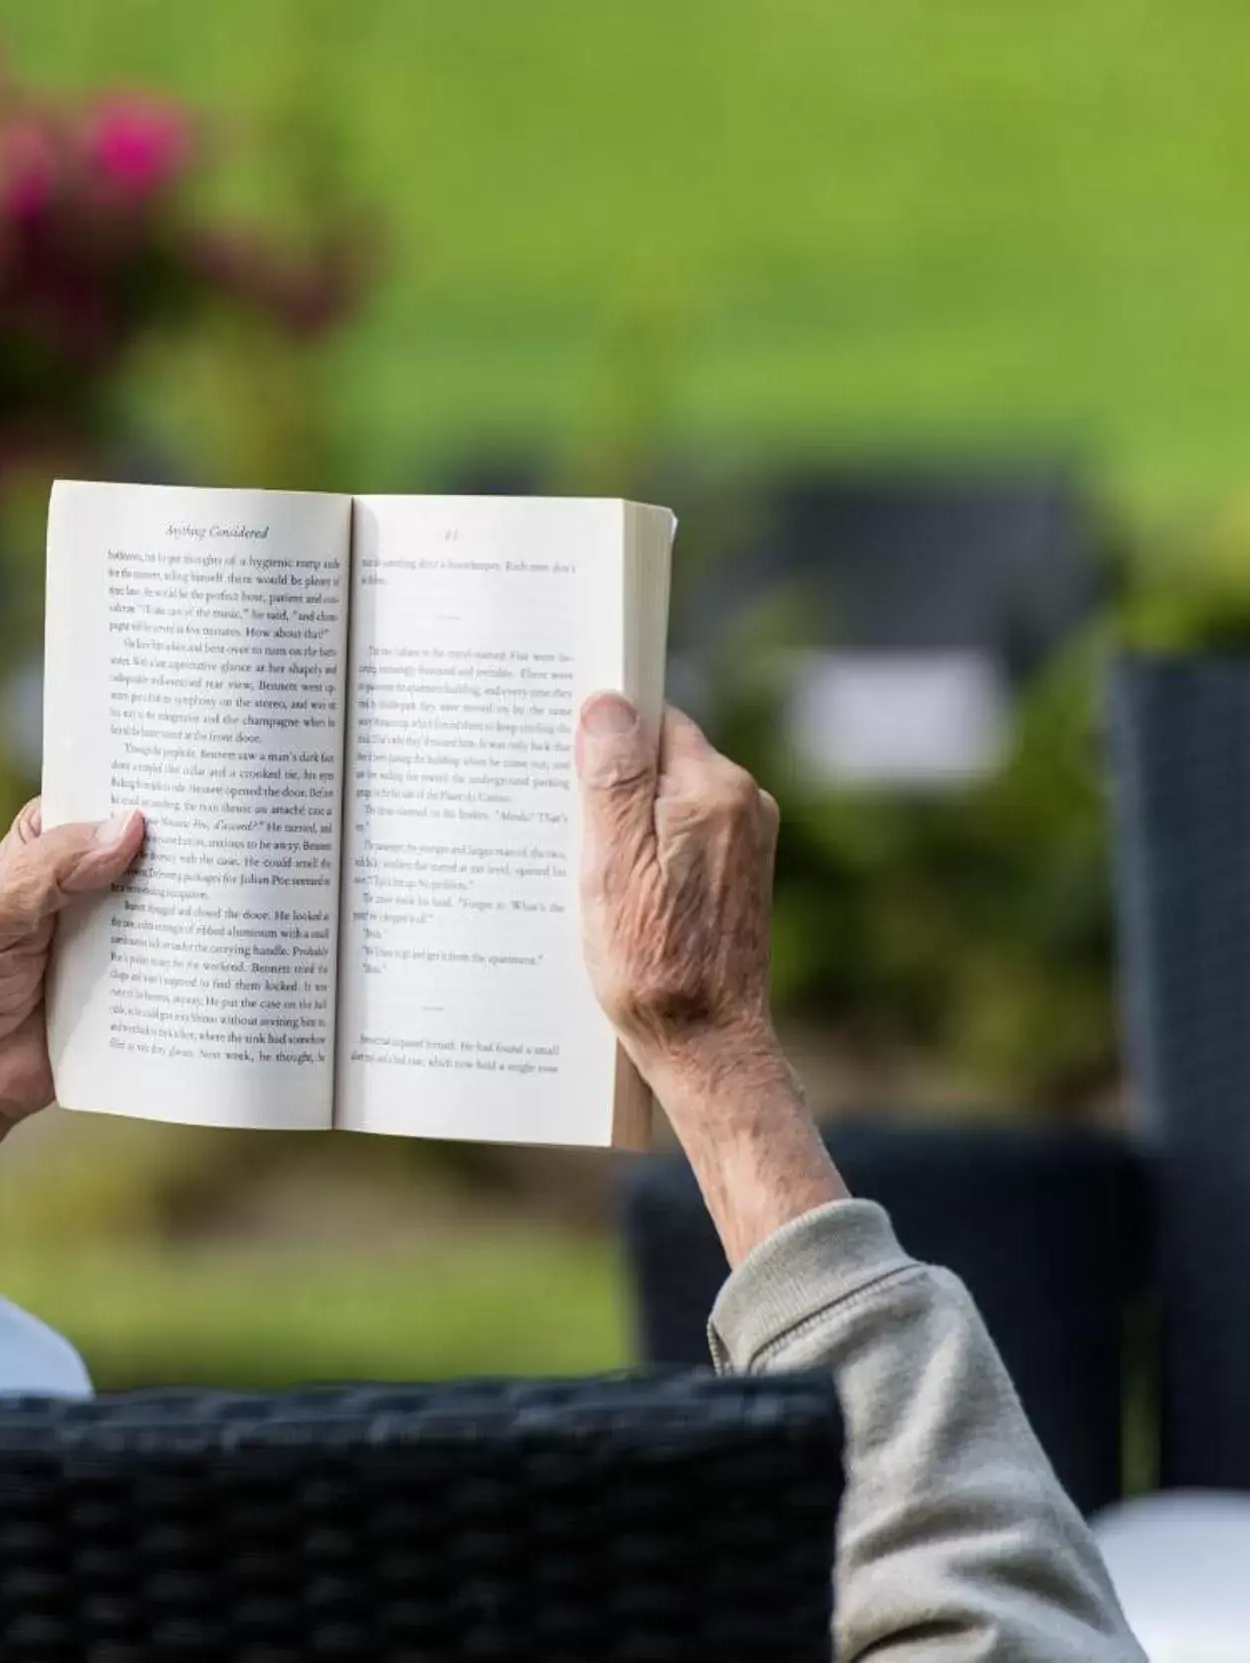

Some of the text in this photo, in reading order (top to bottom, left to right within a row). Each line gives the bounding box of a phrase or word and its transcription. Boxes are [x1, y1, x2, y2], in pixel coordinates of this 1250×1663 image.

[209, 526, 269, 539] Considered
[250, 557, 292, 571] hygienic
[256, 575, 287, 586] would
[269, 593, 304, 606] patient
[306, 594, 323, 604] and
[266, 611, 289, 622] said,
[246, 627, 270, 637] How
[273, 628, 301, 638] about
[269, 663, 285, 673] her
[301, 683, 322, 692] went
[236, 696, 251, 707] the
[255, 698, 288, 710] stereo,
[290, 699, 307, 710] and
[223, 714, 239, 724] the
[243, 715, 299, 729] champagne
[268, 751, 297, 762] man's
[264, 786, 279, 796] the
[263, 857, 292, 868] could
[240, 873, 269, 886] Julian
[224, 906, 238, 918] the
[281, 928, 301, 938] with
[235, 979, 261, 990] them
[221, 998, 238, 1009] put
[241, 998, 256, 1008] the
[260, 1000, 280, 1009] case
[220, 1013, 257, 1026] without
[268, 1032, 287, 1044] had
